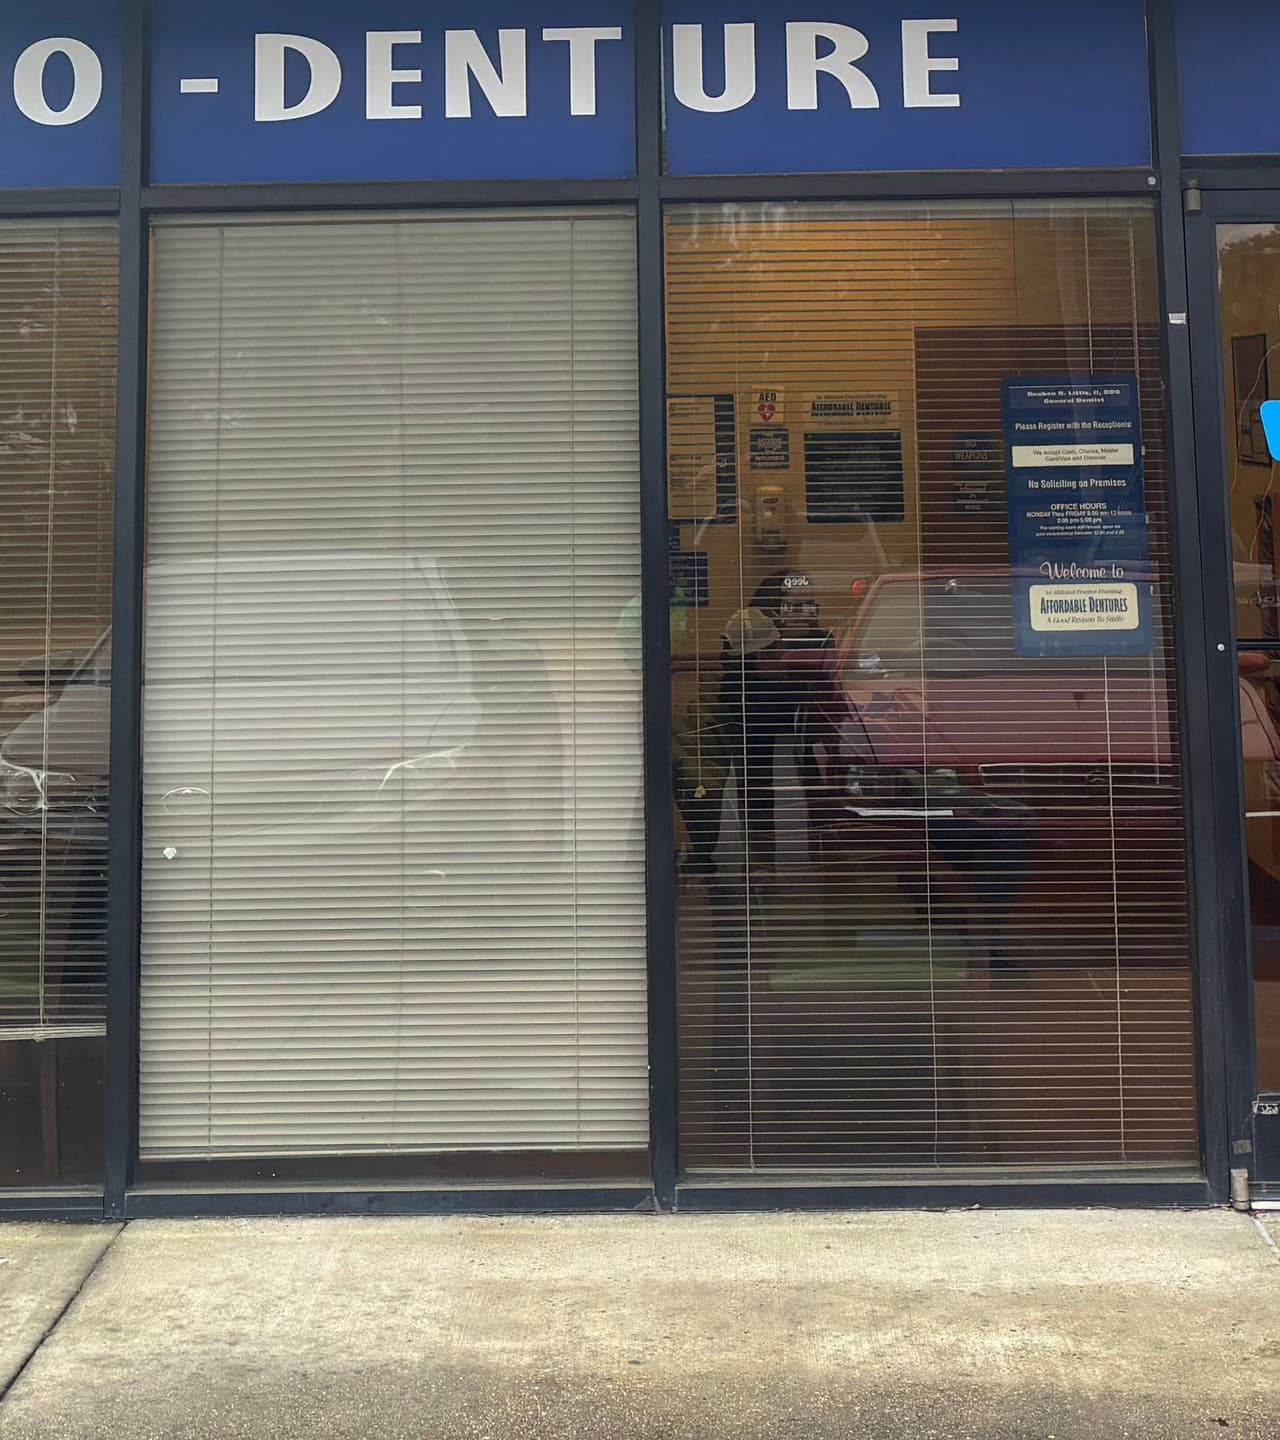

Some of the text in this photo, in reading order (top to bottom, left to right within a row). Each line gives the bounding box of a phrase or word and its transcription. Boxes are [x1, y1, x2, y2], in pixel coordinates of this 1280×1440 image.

[758, 392, 777, 402] AED
[1028, 478, 1127, 490] No Soliciting on Premises
[1040, 561, 1124, 580] Welcome to
[1040, 596, 1128, 615] AFFORDABLE DENTURES
